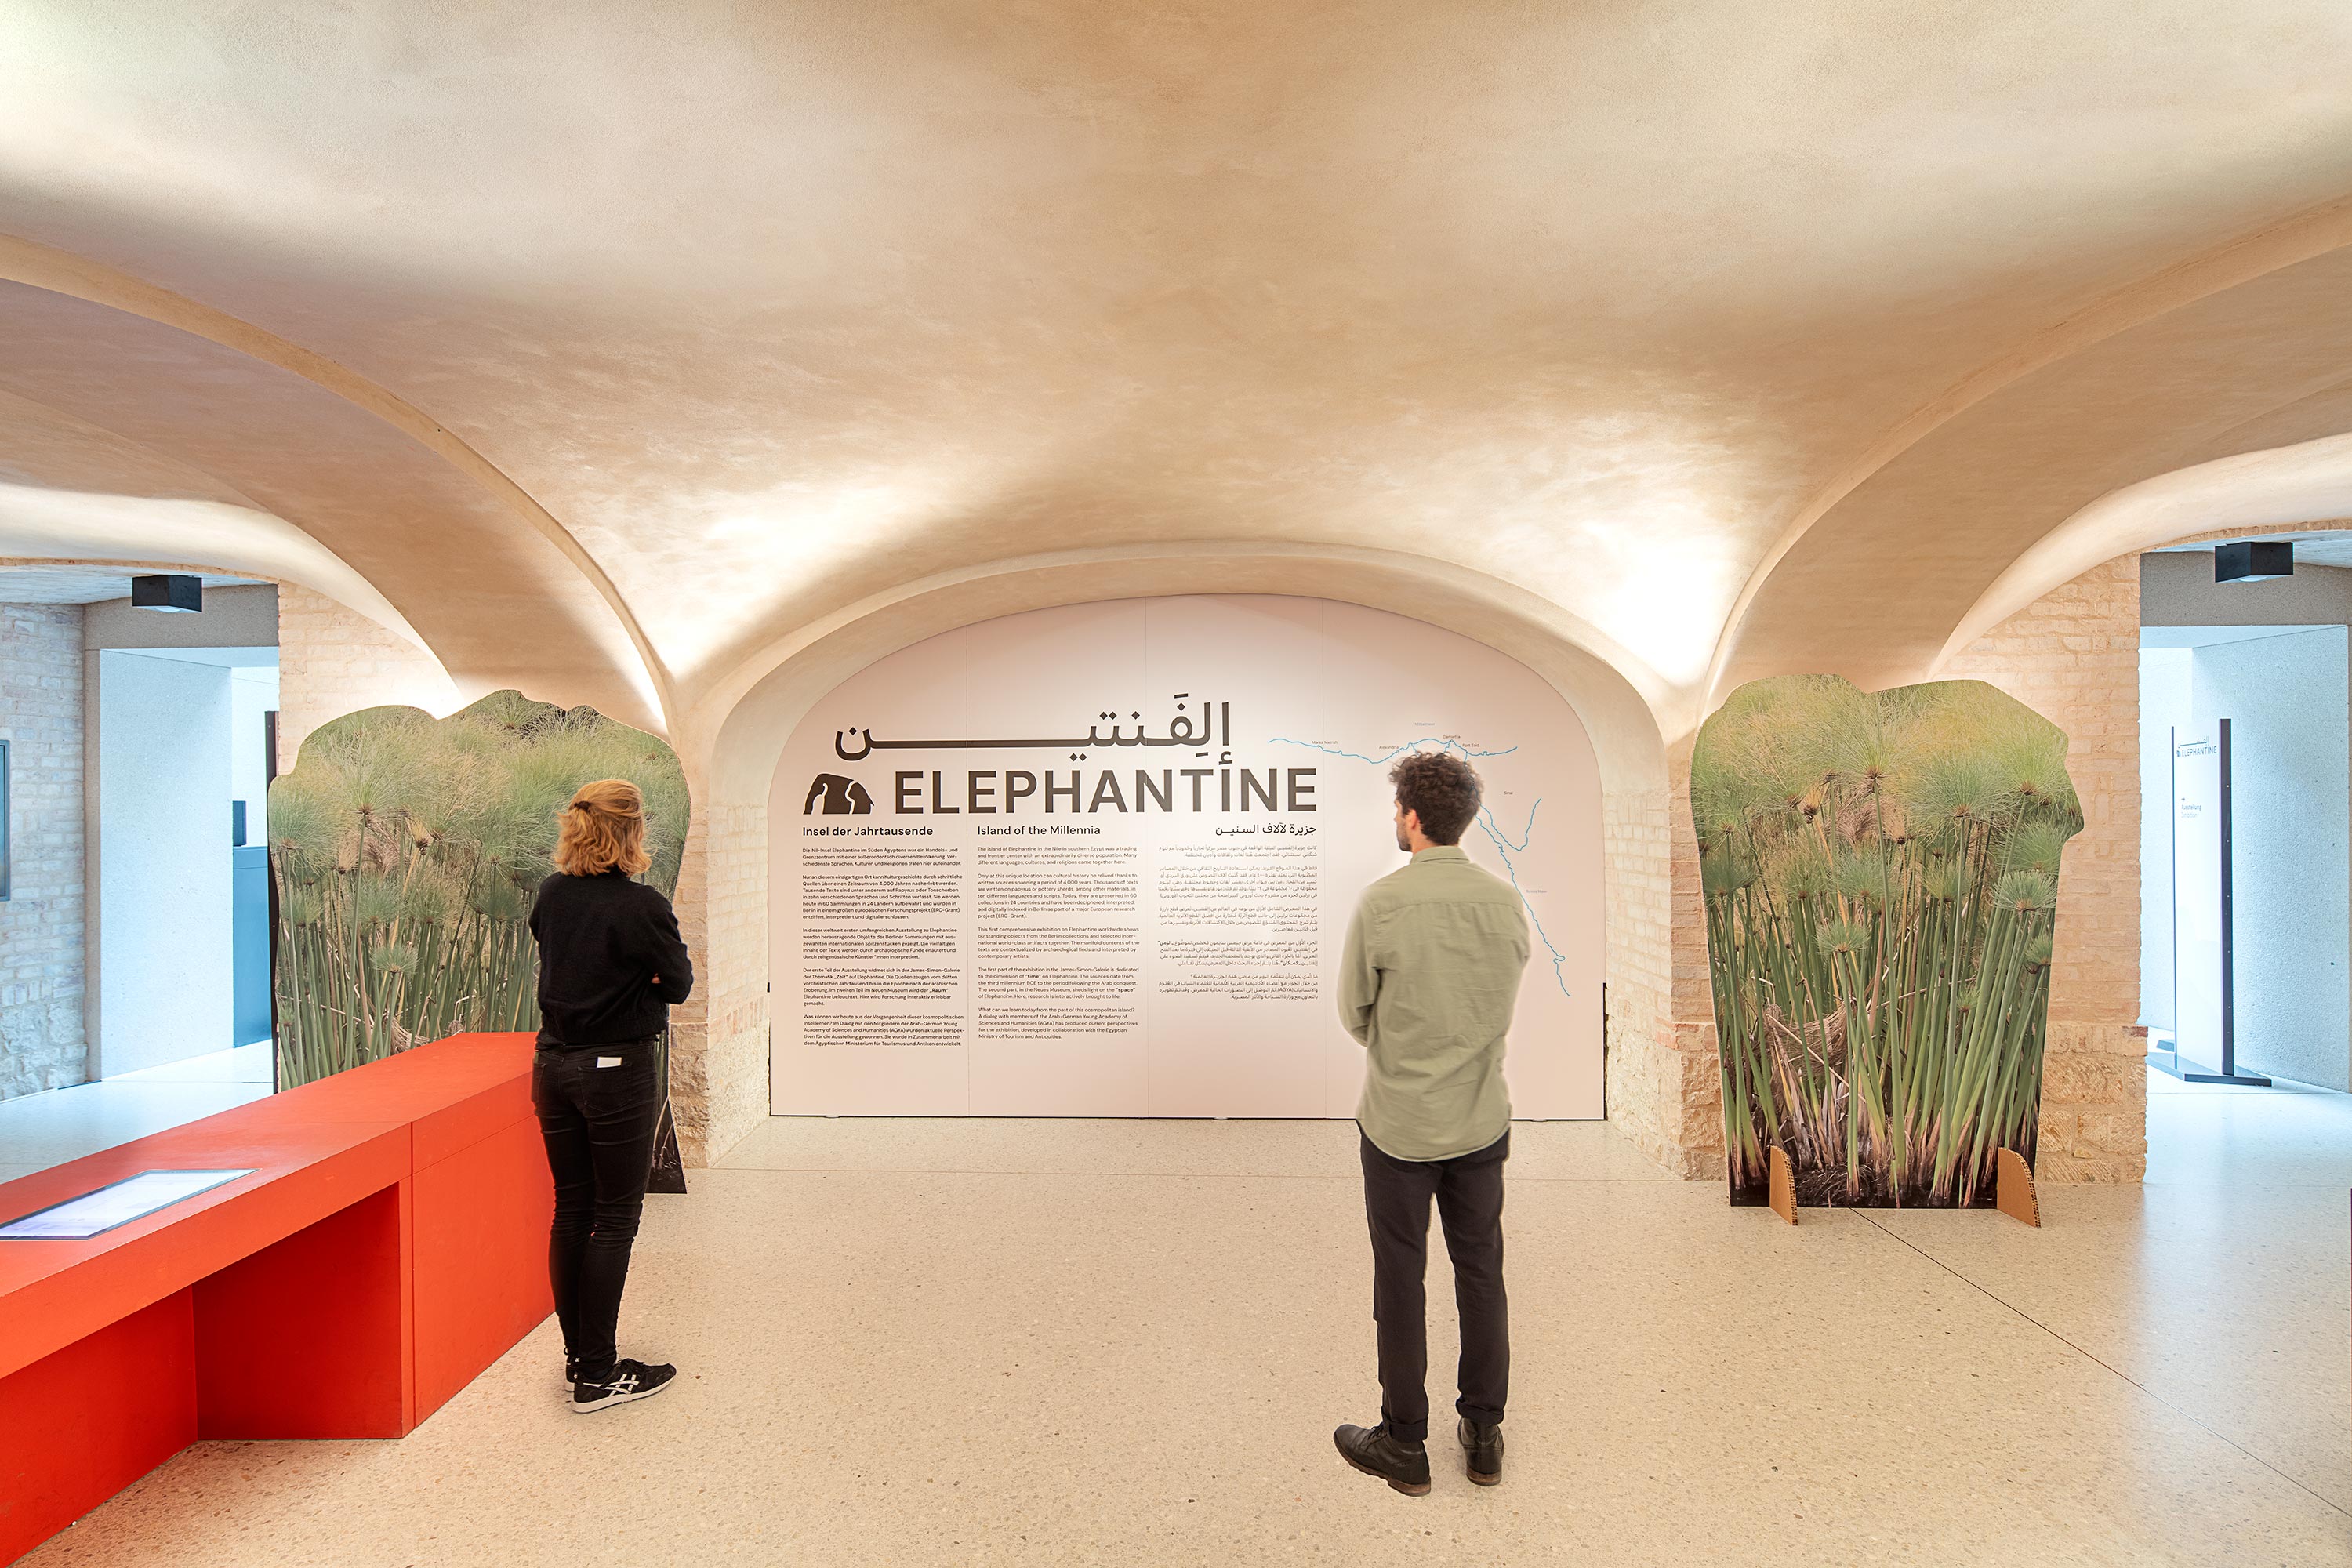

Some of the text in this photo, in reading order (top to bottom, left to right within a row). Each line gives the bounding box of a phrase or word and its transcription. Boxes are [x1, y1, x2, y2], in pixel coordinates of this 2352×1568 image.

[2182, 746, 2217, 757] ELEPHANTINE
[895, 768, 1317, 814] ELEPHANTINE
[803, 826, 933, 836] Insel der Jahrtausende
[978, 825, 1100, 835] Island of the Millennia
[1289, 824, 1317, 836] جزيرة
